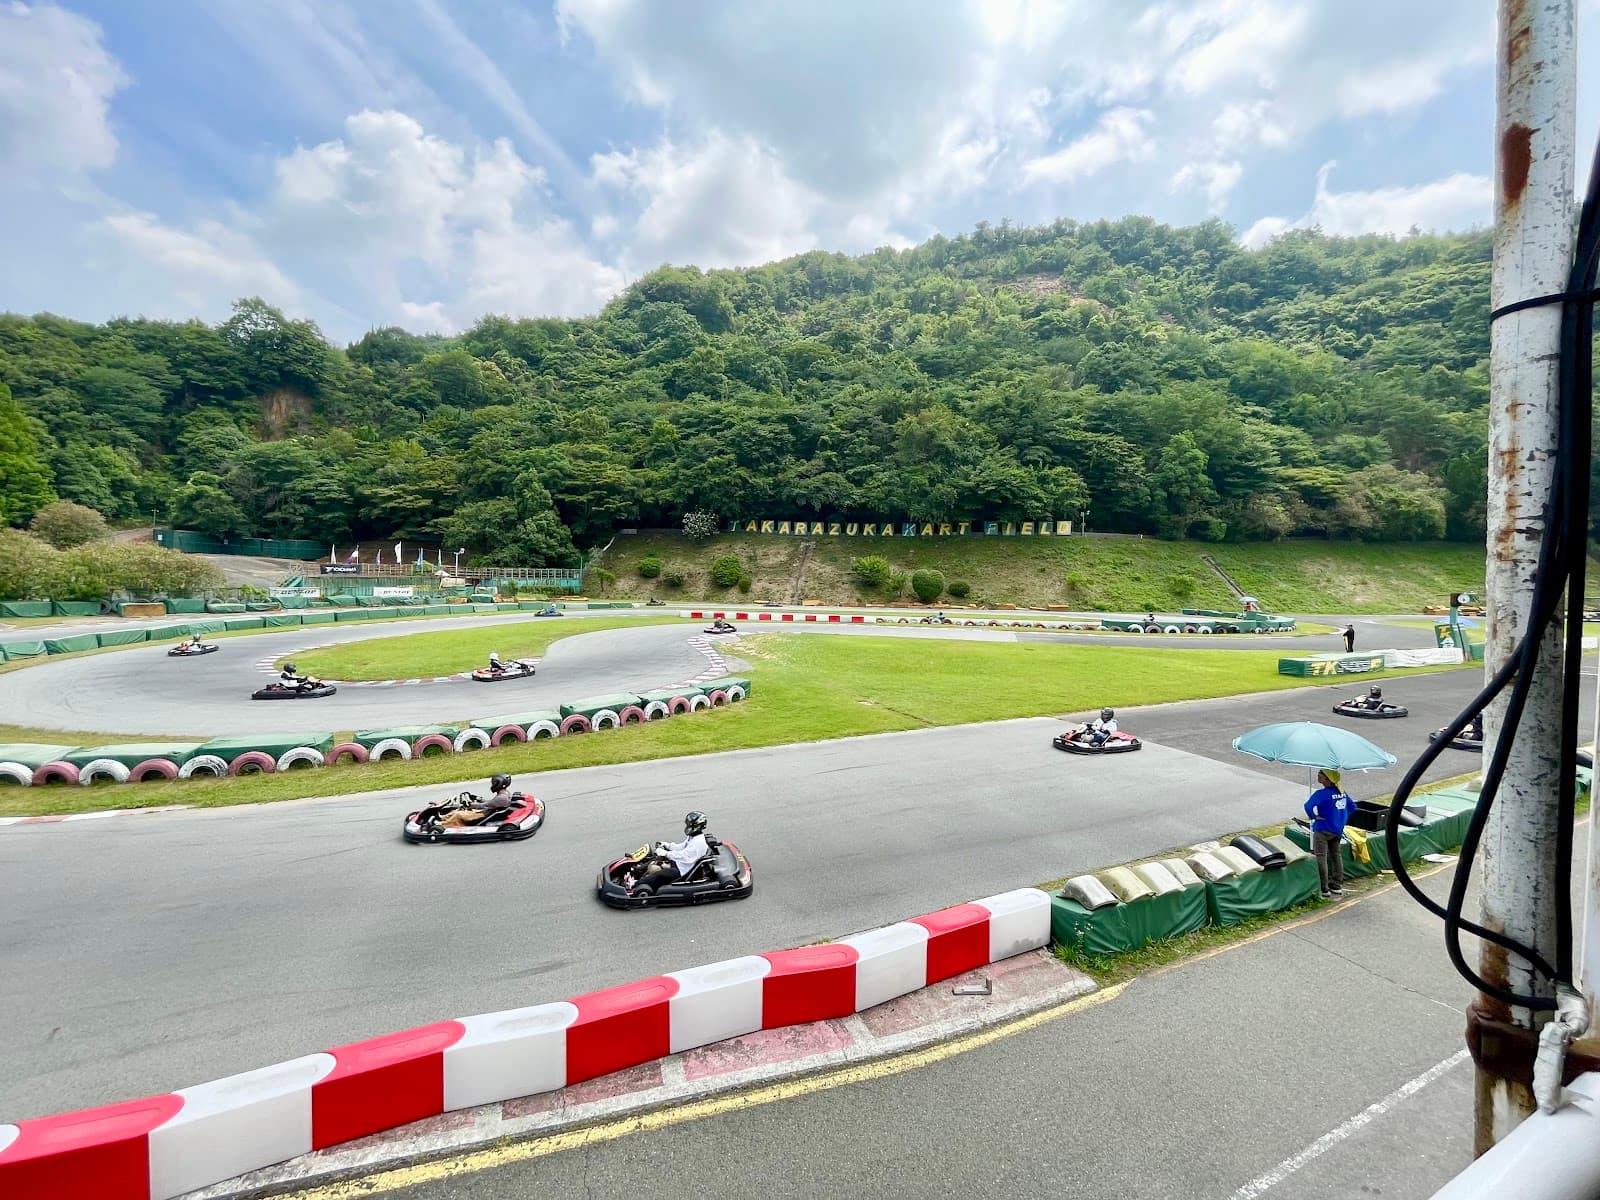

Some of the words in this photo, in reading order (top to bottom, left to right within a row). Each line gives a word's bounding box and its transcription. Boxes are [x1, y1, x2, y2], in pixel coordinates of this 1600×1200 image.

[728, 519, 894, 537] TAKARAZUKA
[903, 522, 970, 537] KART
[985, 521, 1071, 537] FIELD
